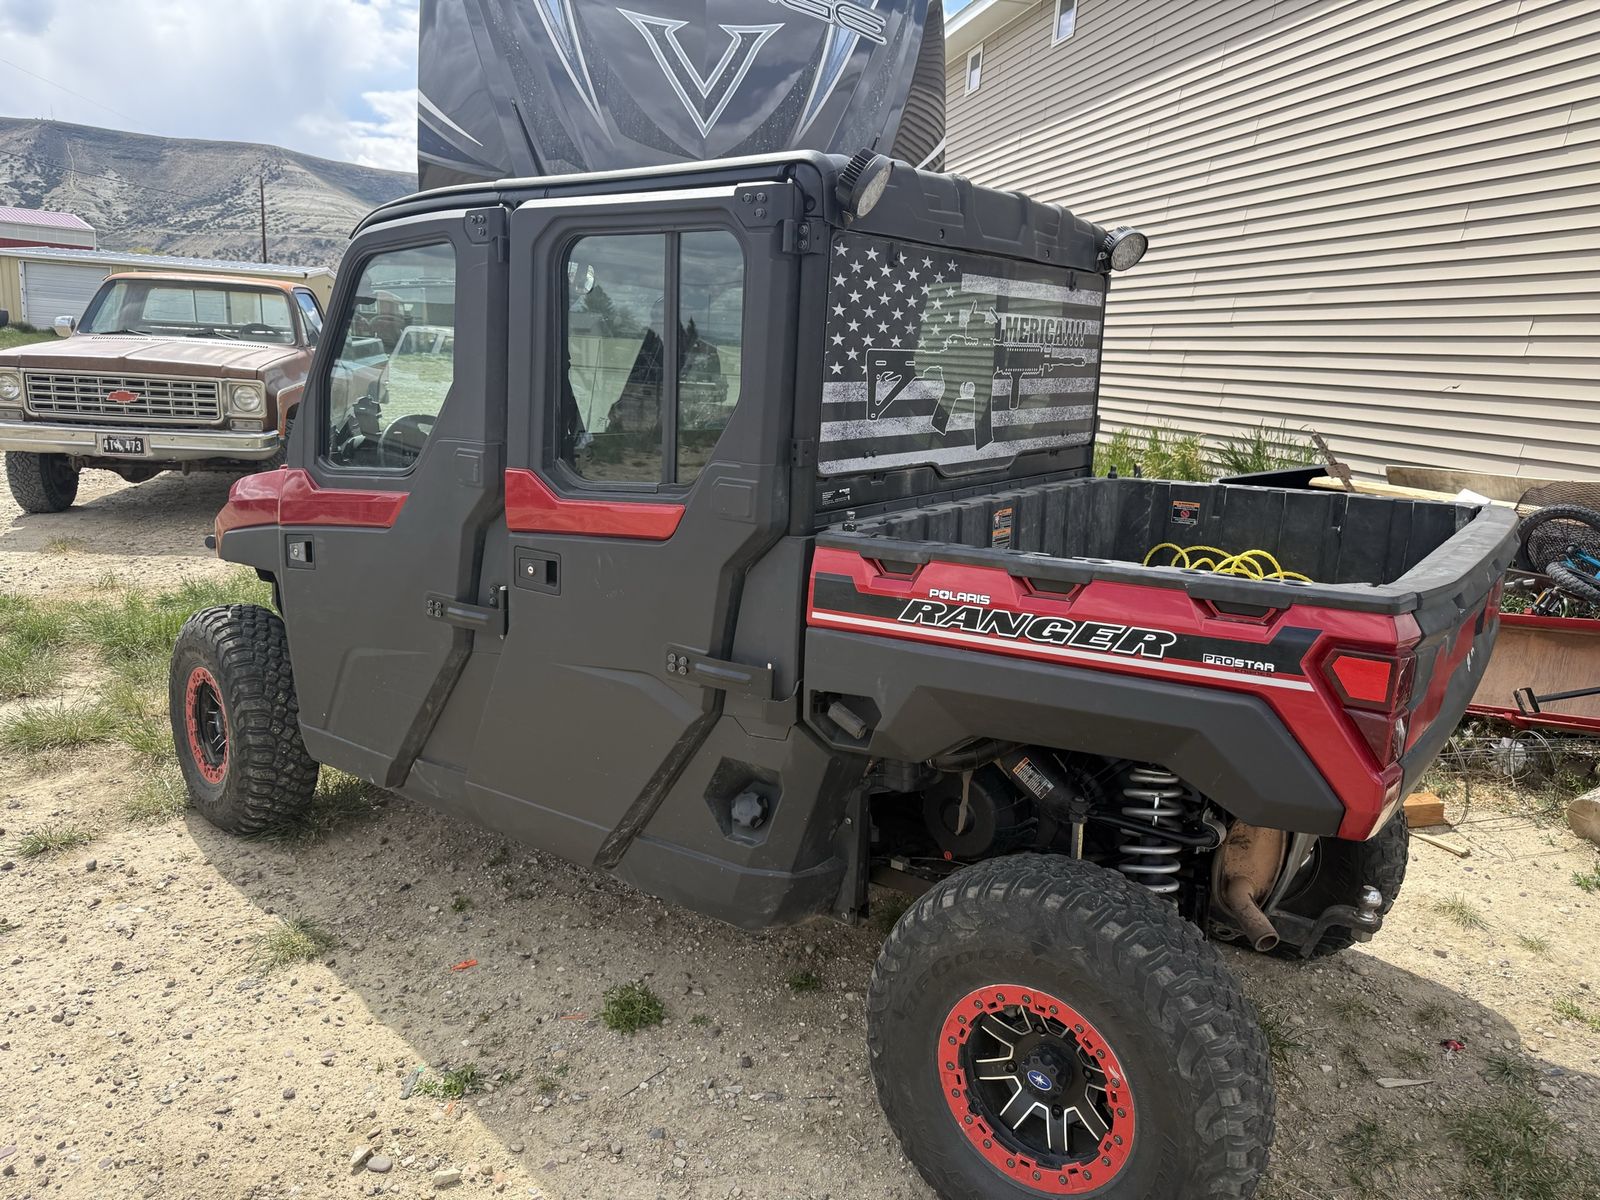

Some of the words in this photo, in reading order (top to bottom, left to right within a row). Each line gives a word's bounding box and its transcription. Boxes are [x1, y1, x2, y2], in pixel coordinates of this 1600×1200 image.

[126, 441, 141, 452] 473
[929, 588, 991, 605] POLARIS
[898, 598, 1177, 658] RANGER
[1202, 652, 1276, 673] PROSTAR
